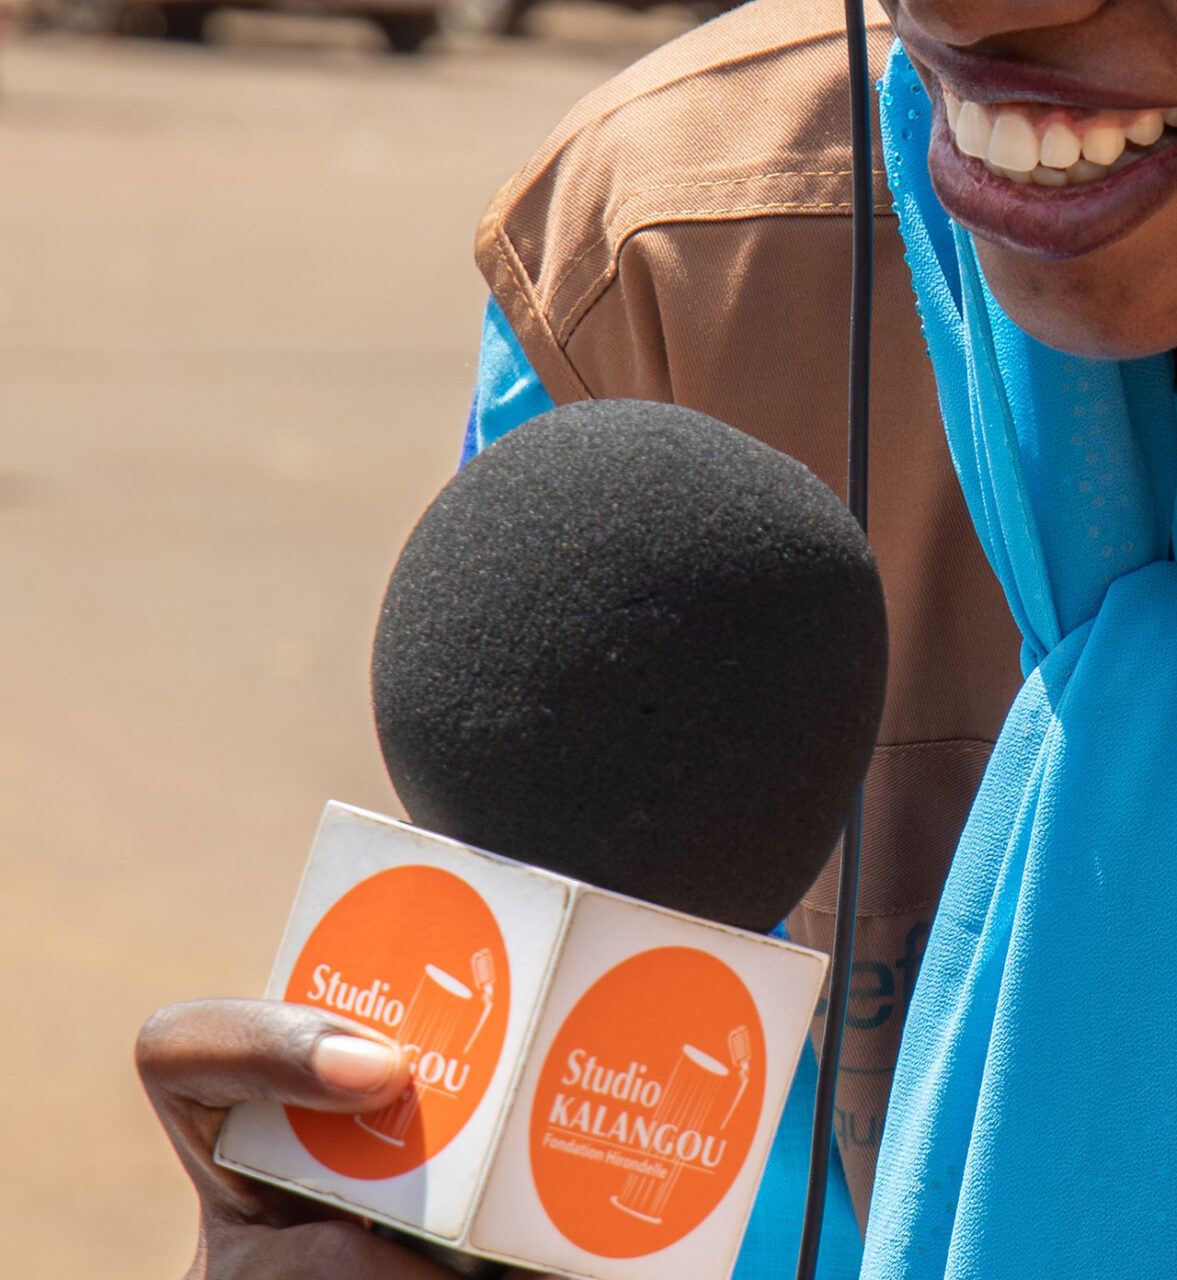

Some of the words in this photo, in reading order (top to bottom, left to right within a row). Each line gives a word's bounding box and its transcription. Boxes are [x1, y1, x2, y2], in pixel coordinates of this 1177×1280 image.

[306, 964, 405, 1027] Studio
[561, 1048, 662, 1108] Studio
[542, 1132, 606, 1164] Fondation
[606, 1149, 669, 1180] Hirondelle
[548, 1093, 727, 1167] KALANGOU
